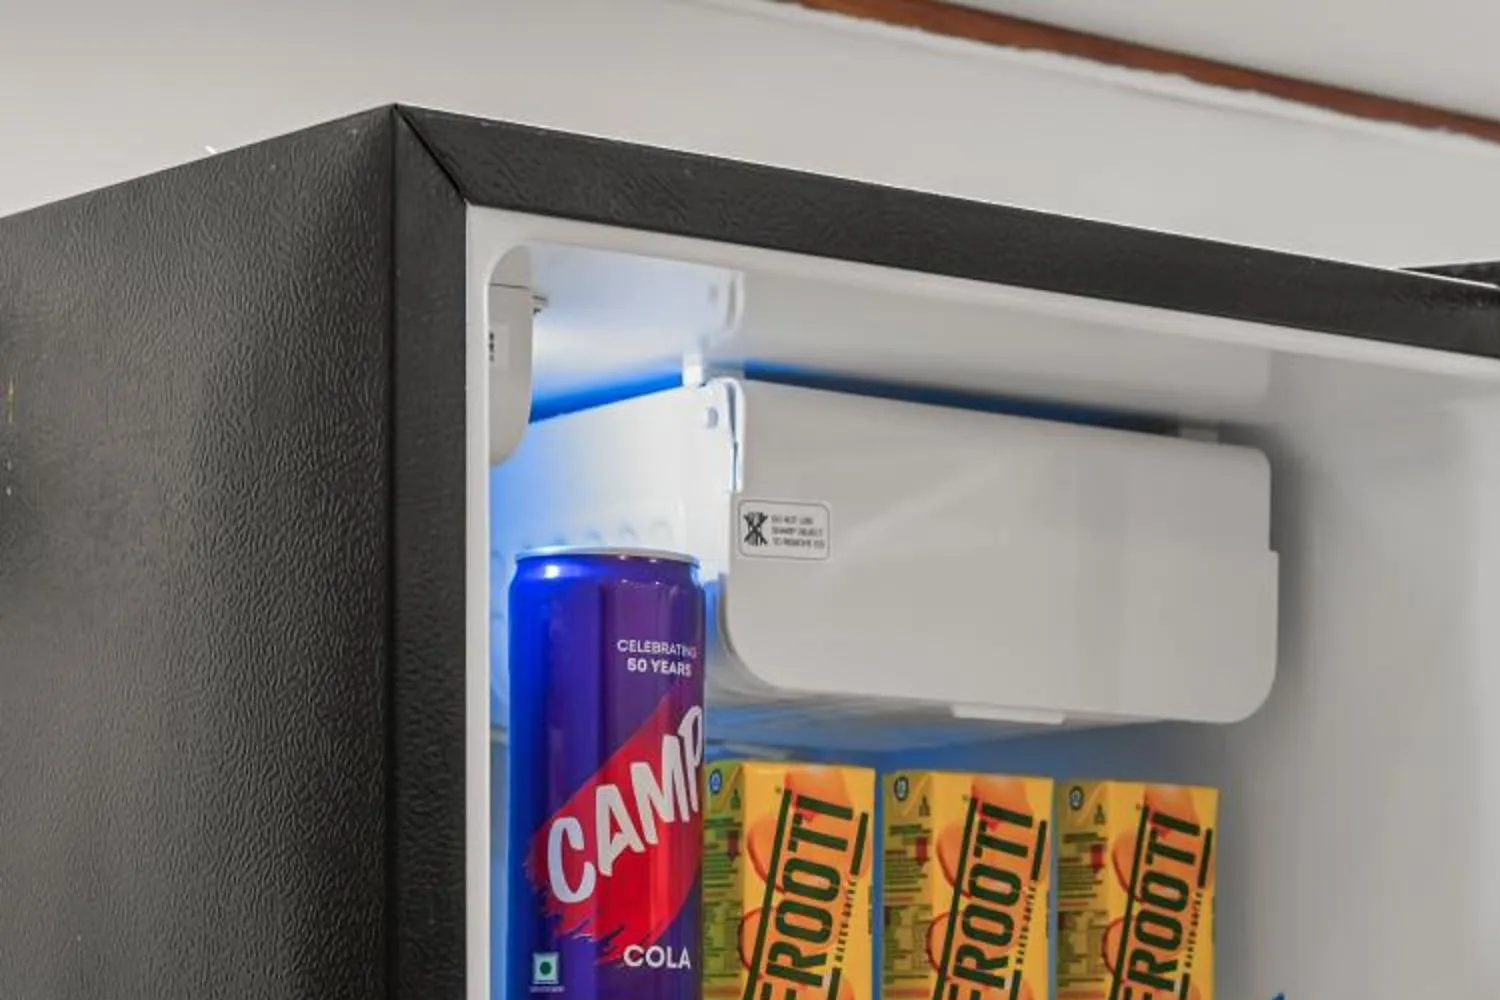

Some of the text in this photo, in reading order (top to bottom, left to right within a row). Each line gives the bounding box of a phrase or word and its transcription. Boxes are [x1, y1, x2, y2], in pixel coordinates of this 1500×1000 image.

[626, 659, 693, 678] 50 YEARS
[623, 945, 691, 970] COLA
